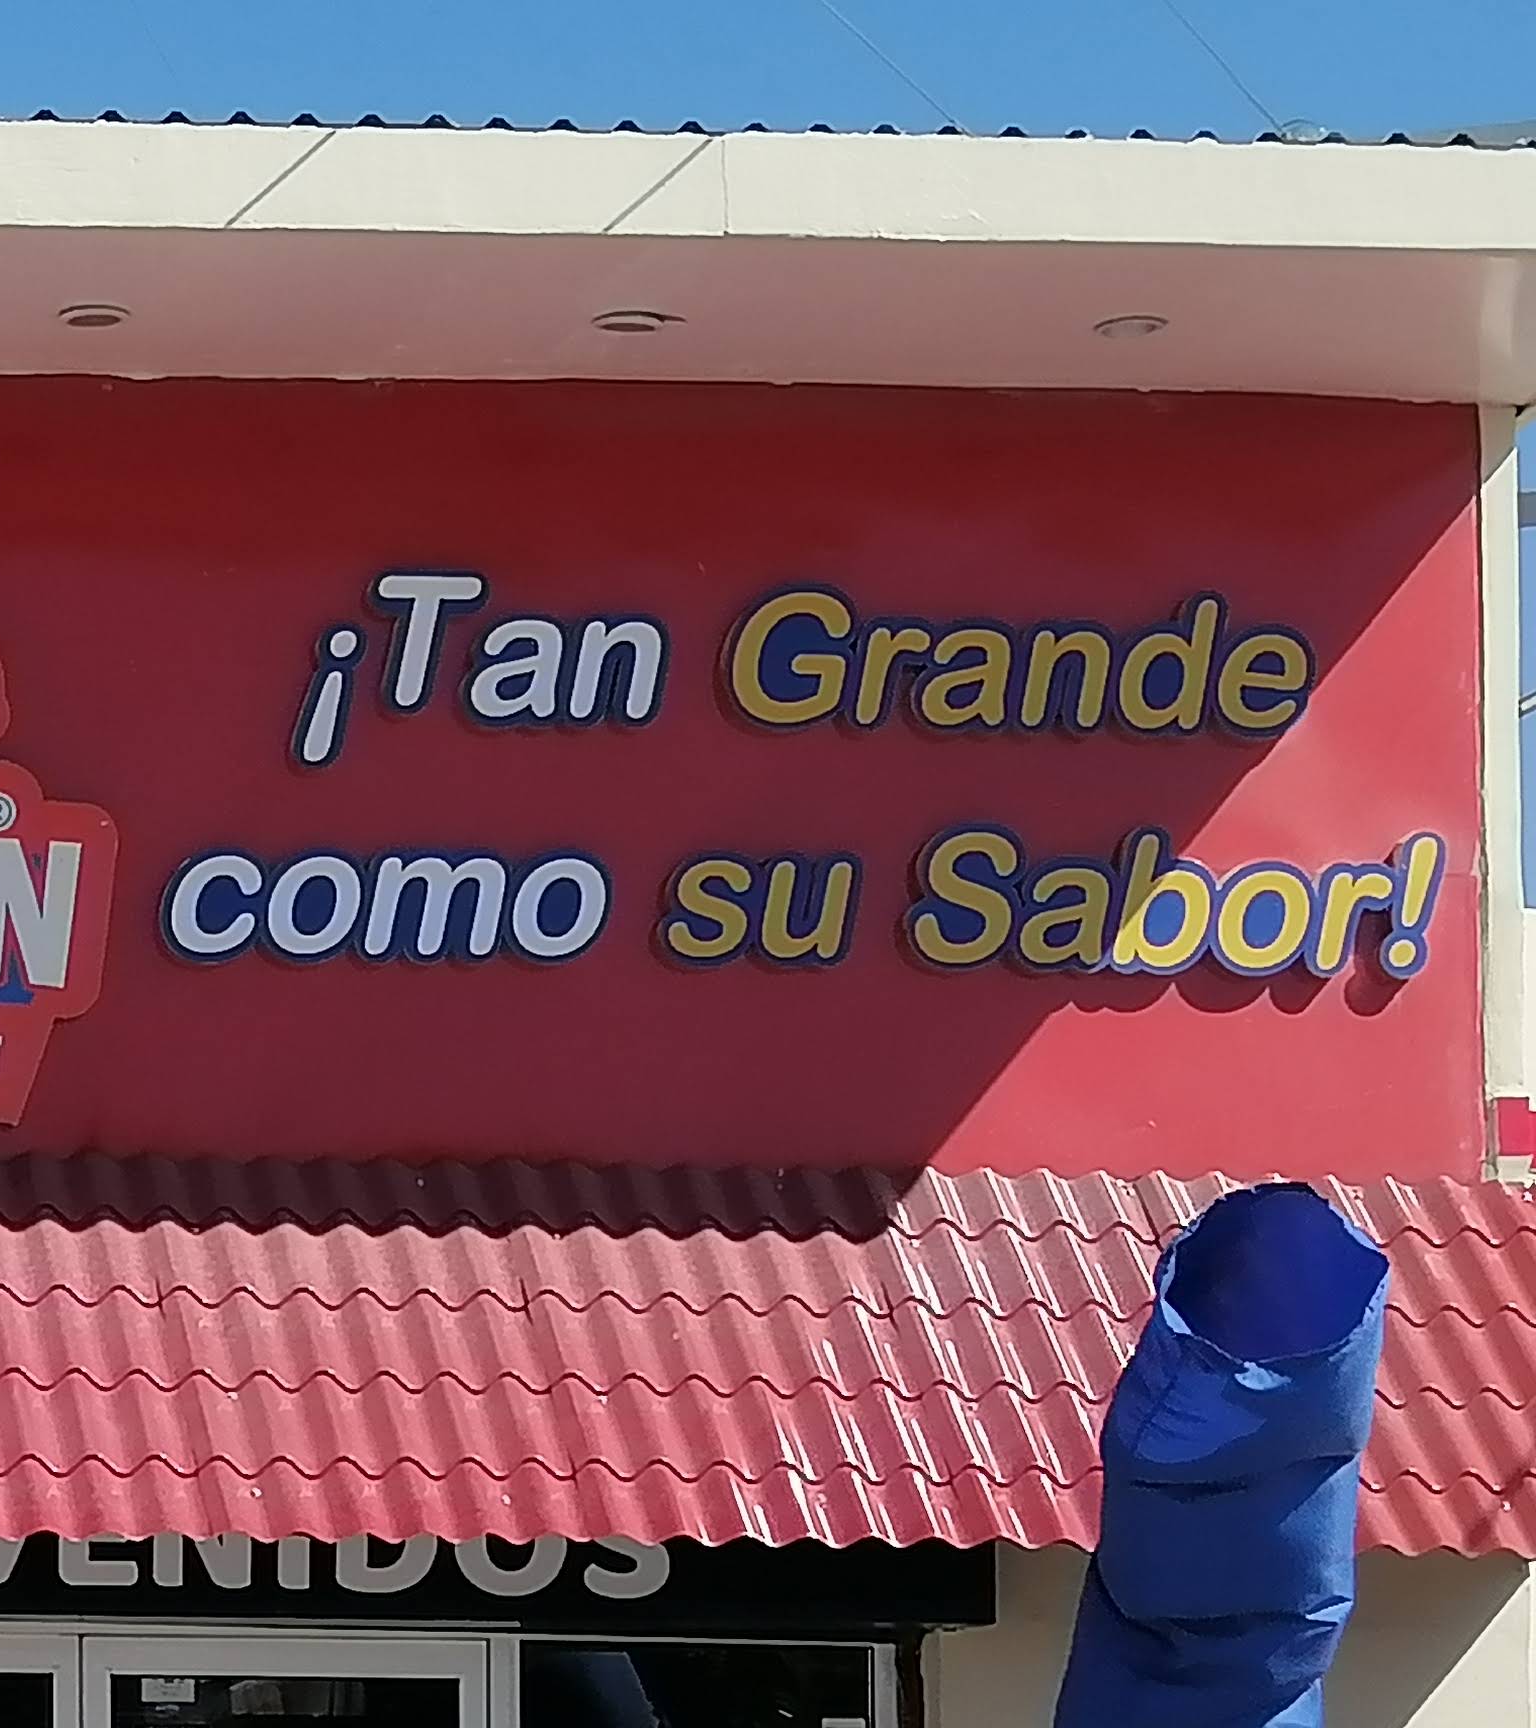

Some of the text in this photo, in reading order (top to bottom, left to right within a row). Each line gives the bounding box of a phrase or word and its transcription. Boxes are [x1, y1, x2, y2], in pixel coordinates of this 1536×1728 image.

[297, 571, 1312, 766] ¡Tan Grande
[167, 827, 1444, 975] como su Sabor!
